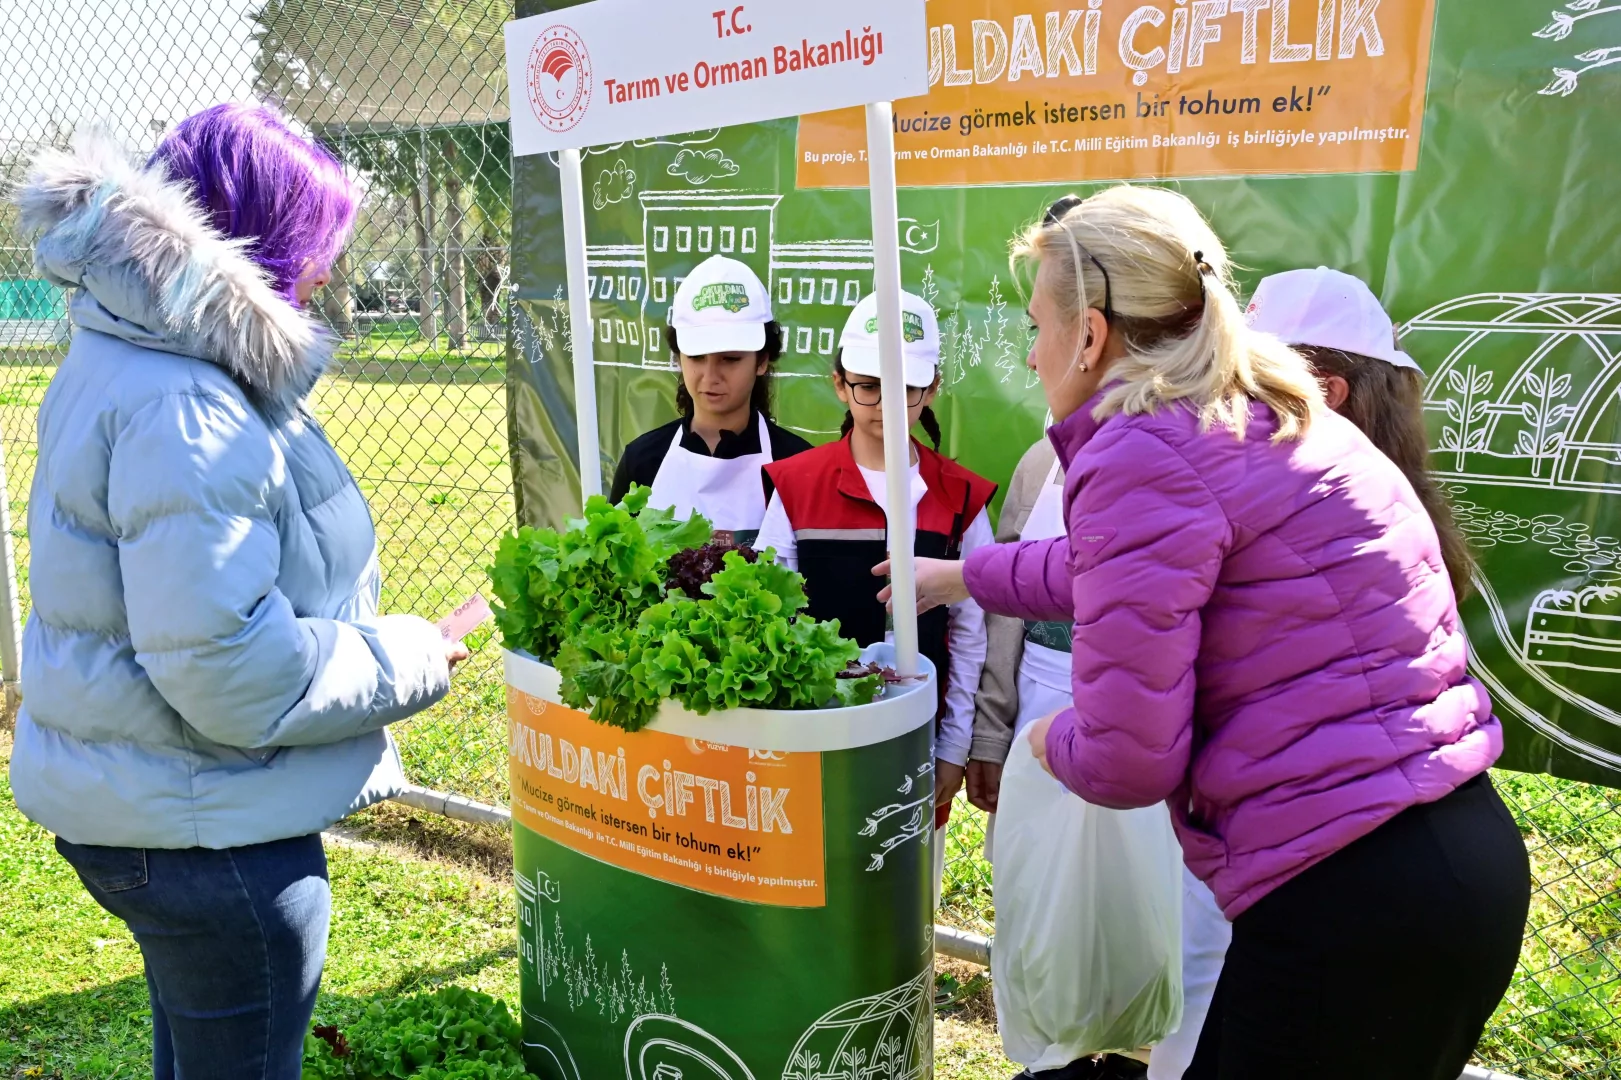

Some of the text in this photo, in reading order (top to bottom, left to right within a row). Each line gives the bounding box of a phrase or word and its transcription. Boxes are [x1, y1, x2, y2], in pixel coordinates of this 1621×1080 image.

[712, 5, 752, 38] T.C.
[604, 25, 883, 104] Tarım ve Orman Bakanlığı
[959, 101, 1036, 136] görmek
[1044, 101, 1126, 124] istersen
[1136, 92, 1170, 117] bir
[1179, 90, 1260, 115] tohum
[804, 151, 819, 162] Bu
[822, 150, 856, 164] proje,
[914, 150, 928, 159] ve
[930, 146, 970, 159] Orman
[973, 142, 1027, 158] Bakanlığı
[1032, 141, 1048, 154] ile
[1050, 139, 1071, 153] T.C.
[1105, 135, 1148, 153] Eğitim
[1152, 131, 1220, 149] Bakanlığı
[1228, 130, 1240, 146] iş
[1243, 126, 1314, 147] birliğiyle
[1318, 126, 1409, 146] yapılmıştır.
[637, 758, 793, 834] ÇİFTLİK
[545, 812, 564, 826] Orman
[565, 820, 594, 839] Bakanlığı
[596, 832, 605, 843] ile
[605, 835, 618, 847] T.C.
[636, 846, 662, 861] Eğitim
[663, 853, 702, 872] Bakanlığı
[705, 864, 713, 875] iş
[714, 866, 755, 883] birliğiyle
[757, 876, 818, 889] yapılmıştır.
[557, 797, 597, 821] görmek
[600, 809, 647, 837] istersen
[652, 822, 671, 843] bir
[676, 832, 720, 855] tohum
